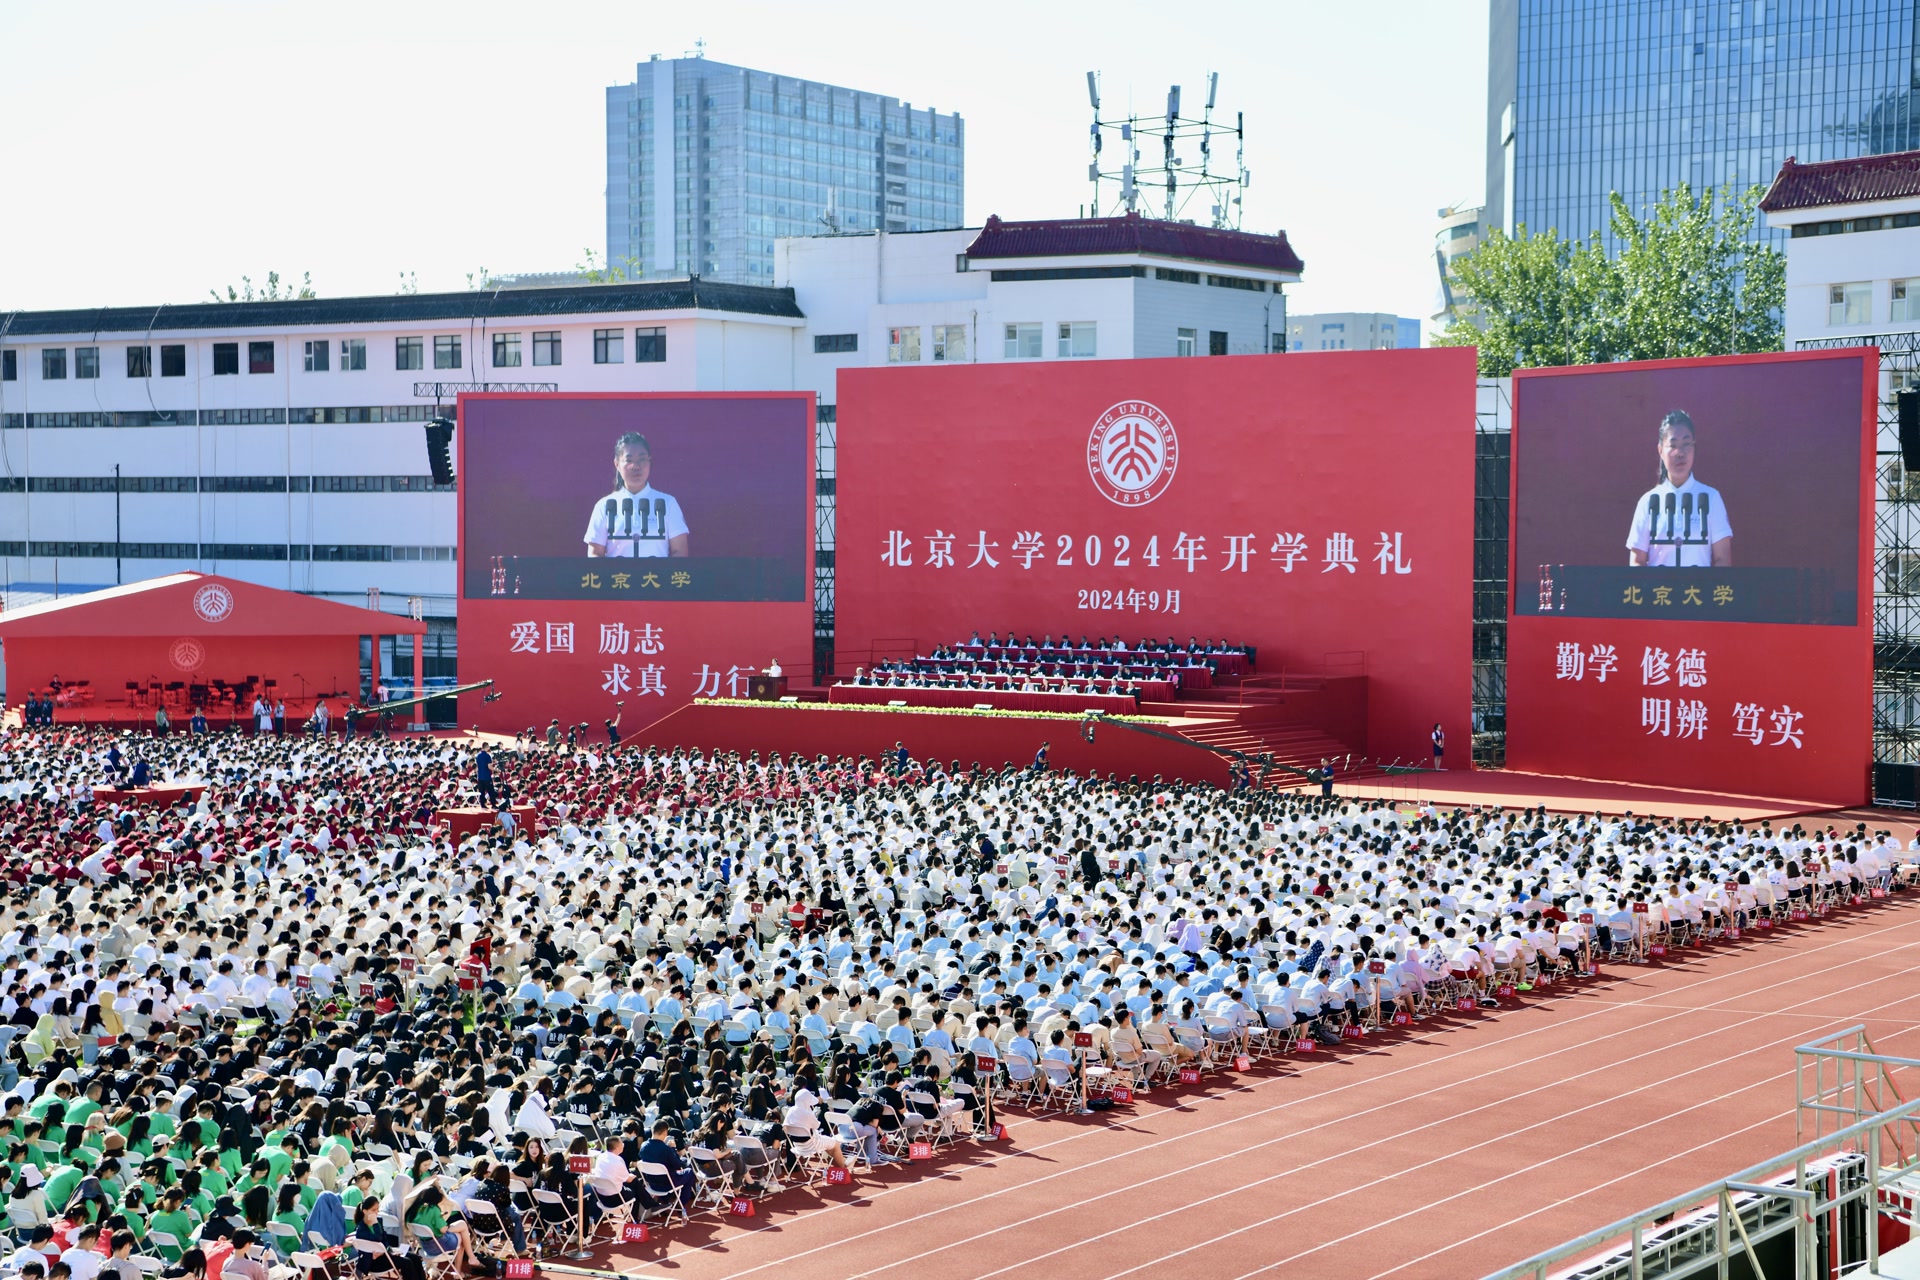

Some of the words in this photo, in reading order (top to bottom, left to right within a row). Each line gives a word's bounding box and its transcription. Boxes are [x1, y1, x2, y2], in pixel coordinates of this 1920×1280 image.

[1090, 414, 1113, 474] PEKING
[1118, 404, 1175, 475] UNIVERSITY
[1113, 490, 1151, 503] 1898
[880, 529, 1413, 575] 北京大学2024年开学典礼
[580, 571, 692, 589] 北京大学
[1077, 588, 1181, 614] 2024年9月
[1623, 585, 1735, 606] 北京大学
[510, 621, 575, 654] 爱国
[598, 622, 665, 654] 励志
[1555, 641, 1619, 683] 勤学
[1640, 646, 1708, 688] 修德
[602, 663, 668, 698] 求真
[692, 663, 756, 697] 力行
[1641, 697, 1709, 740] 明辨
[1732, 702, 1804, 749] 笃实
[1499, 987, 1512, 996] 5排
[1459, 1000, 1472, 1010] 7排
[1395, 1014, 1407, 1025] 9排
[1344, 1026, 1361, 1038] 11排
[1296, 1040, 1313, 1050] 13排
[1181, 1071, 1198, 1082] 17排
[1112, 1089, 1129, 1101] 19排
[912, 1145, 930, 1157] 3排
[829, 1170, 846, 1182] 5排
[733, 1201, 748, 1214] 7排
[625, 1226, 643, 1239] 9排
[507, 1262, 532, 1276] 11排
